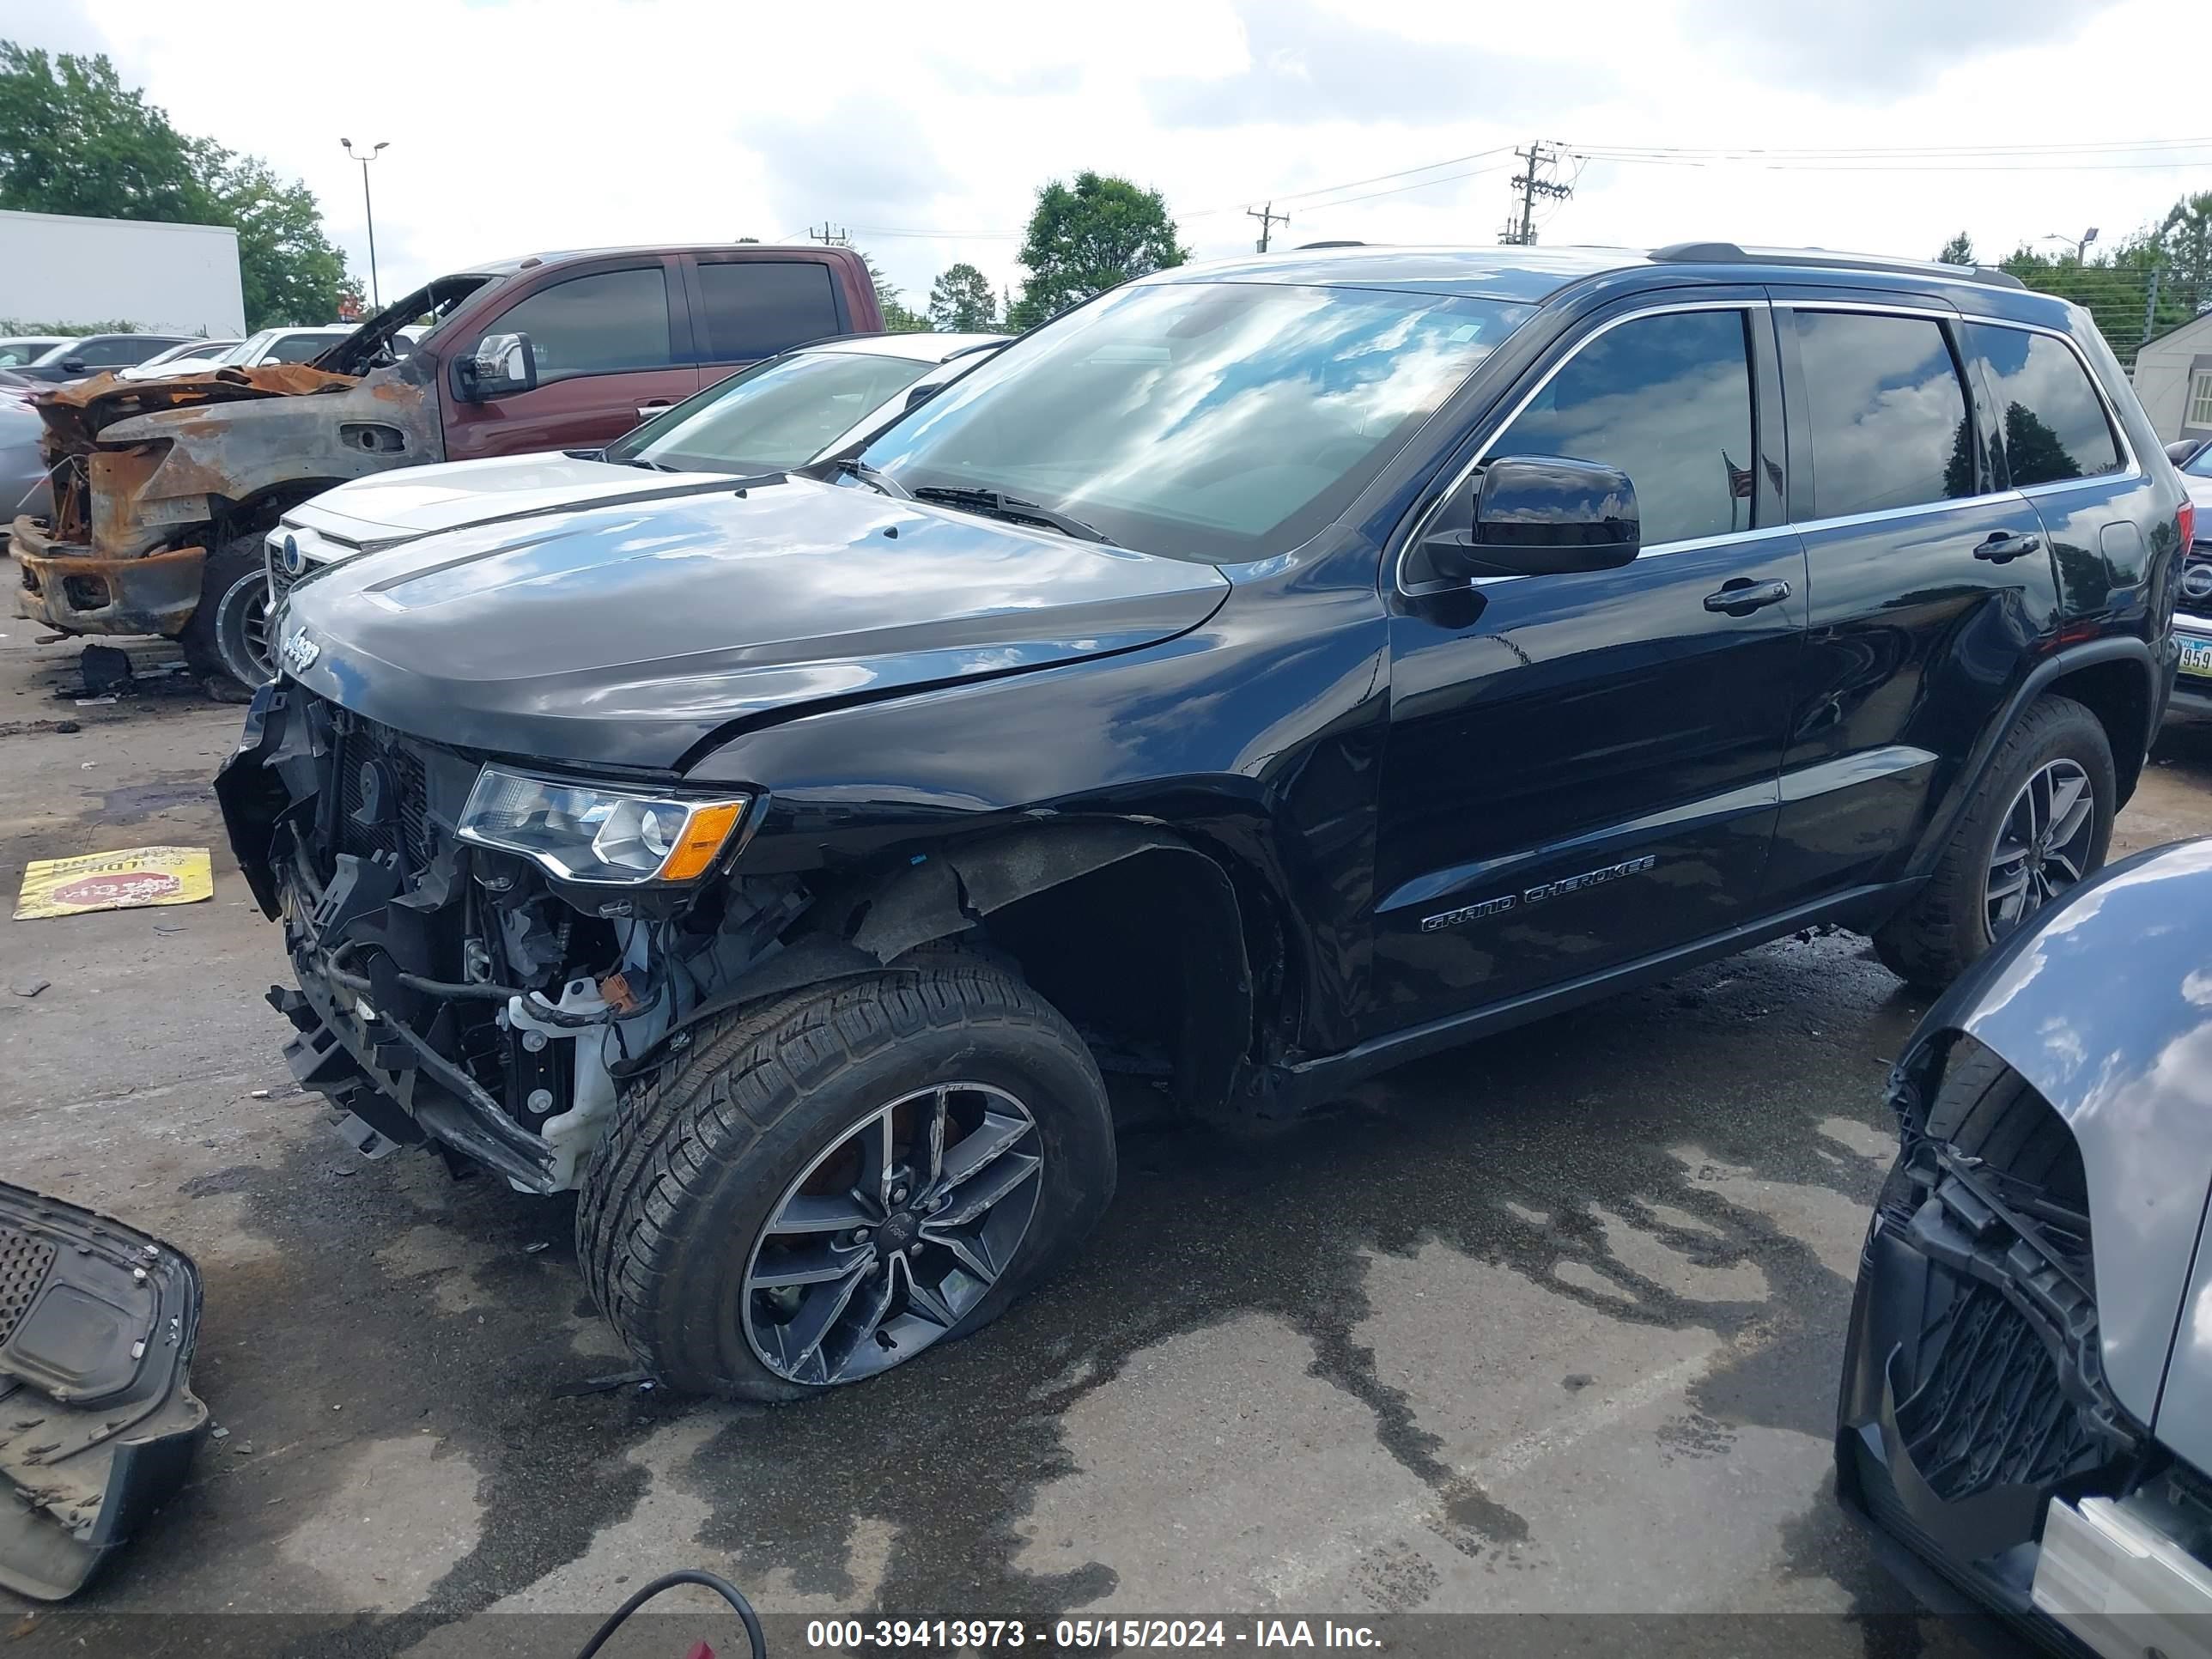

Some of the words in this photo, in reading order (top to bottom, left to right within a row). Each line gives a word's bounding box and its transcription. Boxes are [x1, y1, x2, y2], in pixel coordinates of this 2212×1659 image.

[283, 626, 320, 673] Jeep
[1421, 895, 1516, 932] GRAND
[1522, 854, 1656, 902] CHEROKEE
